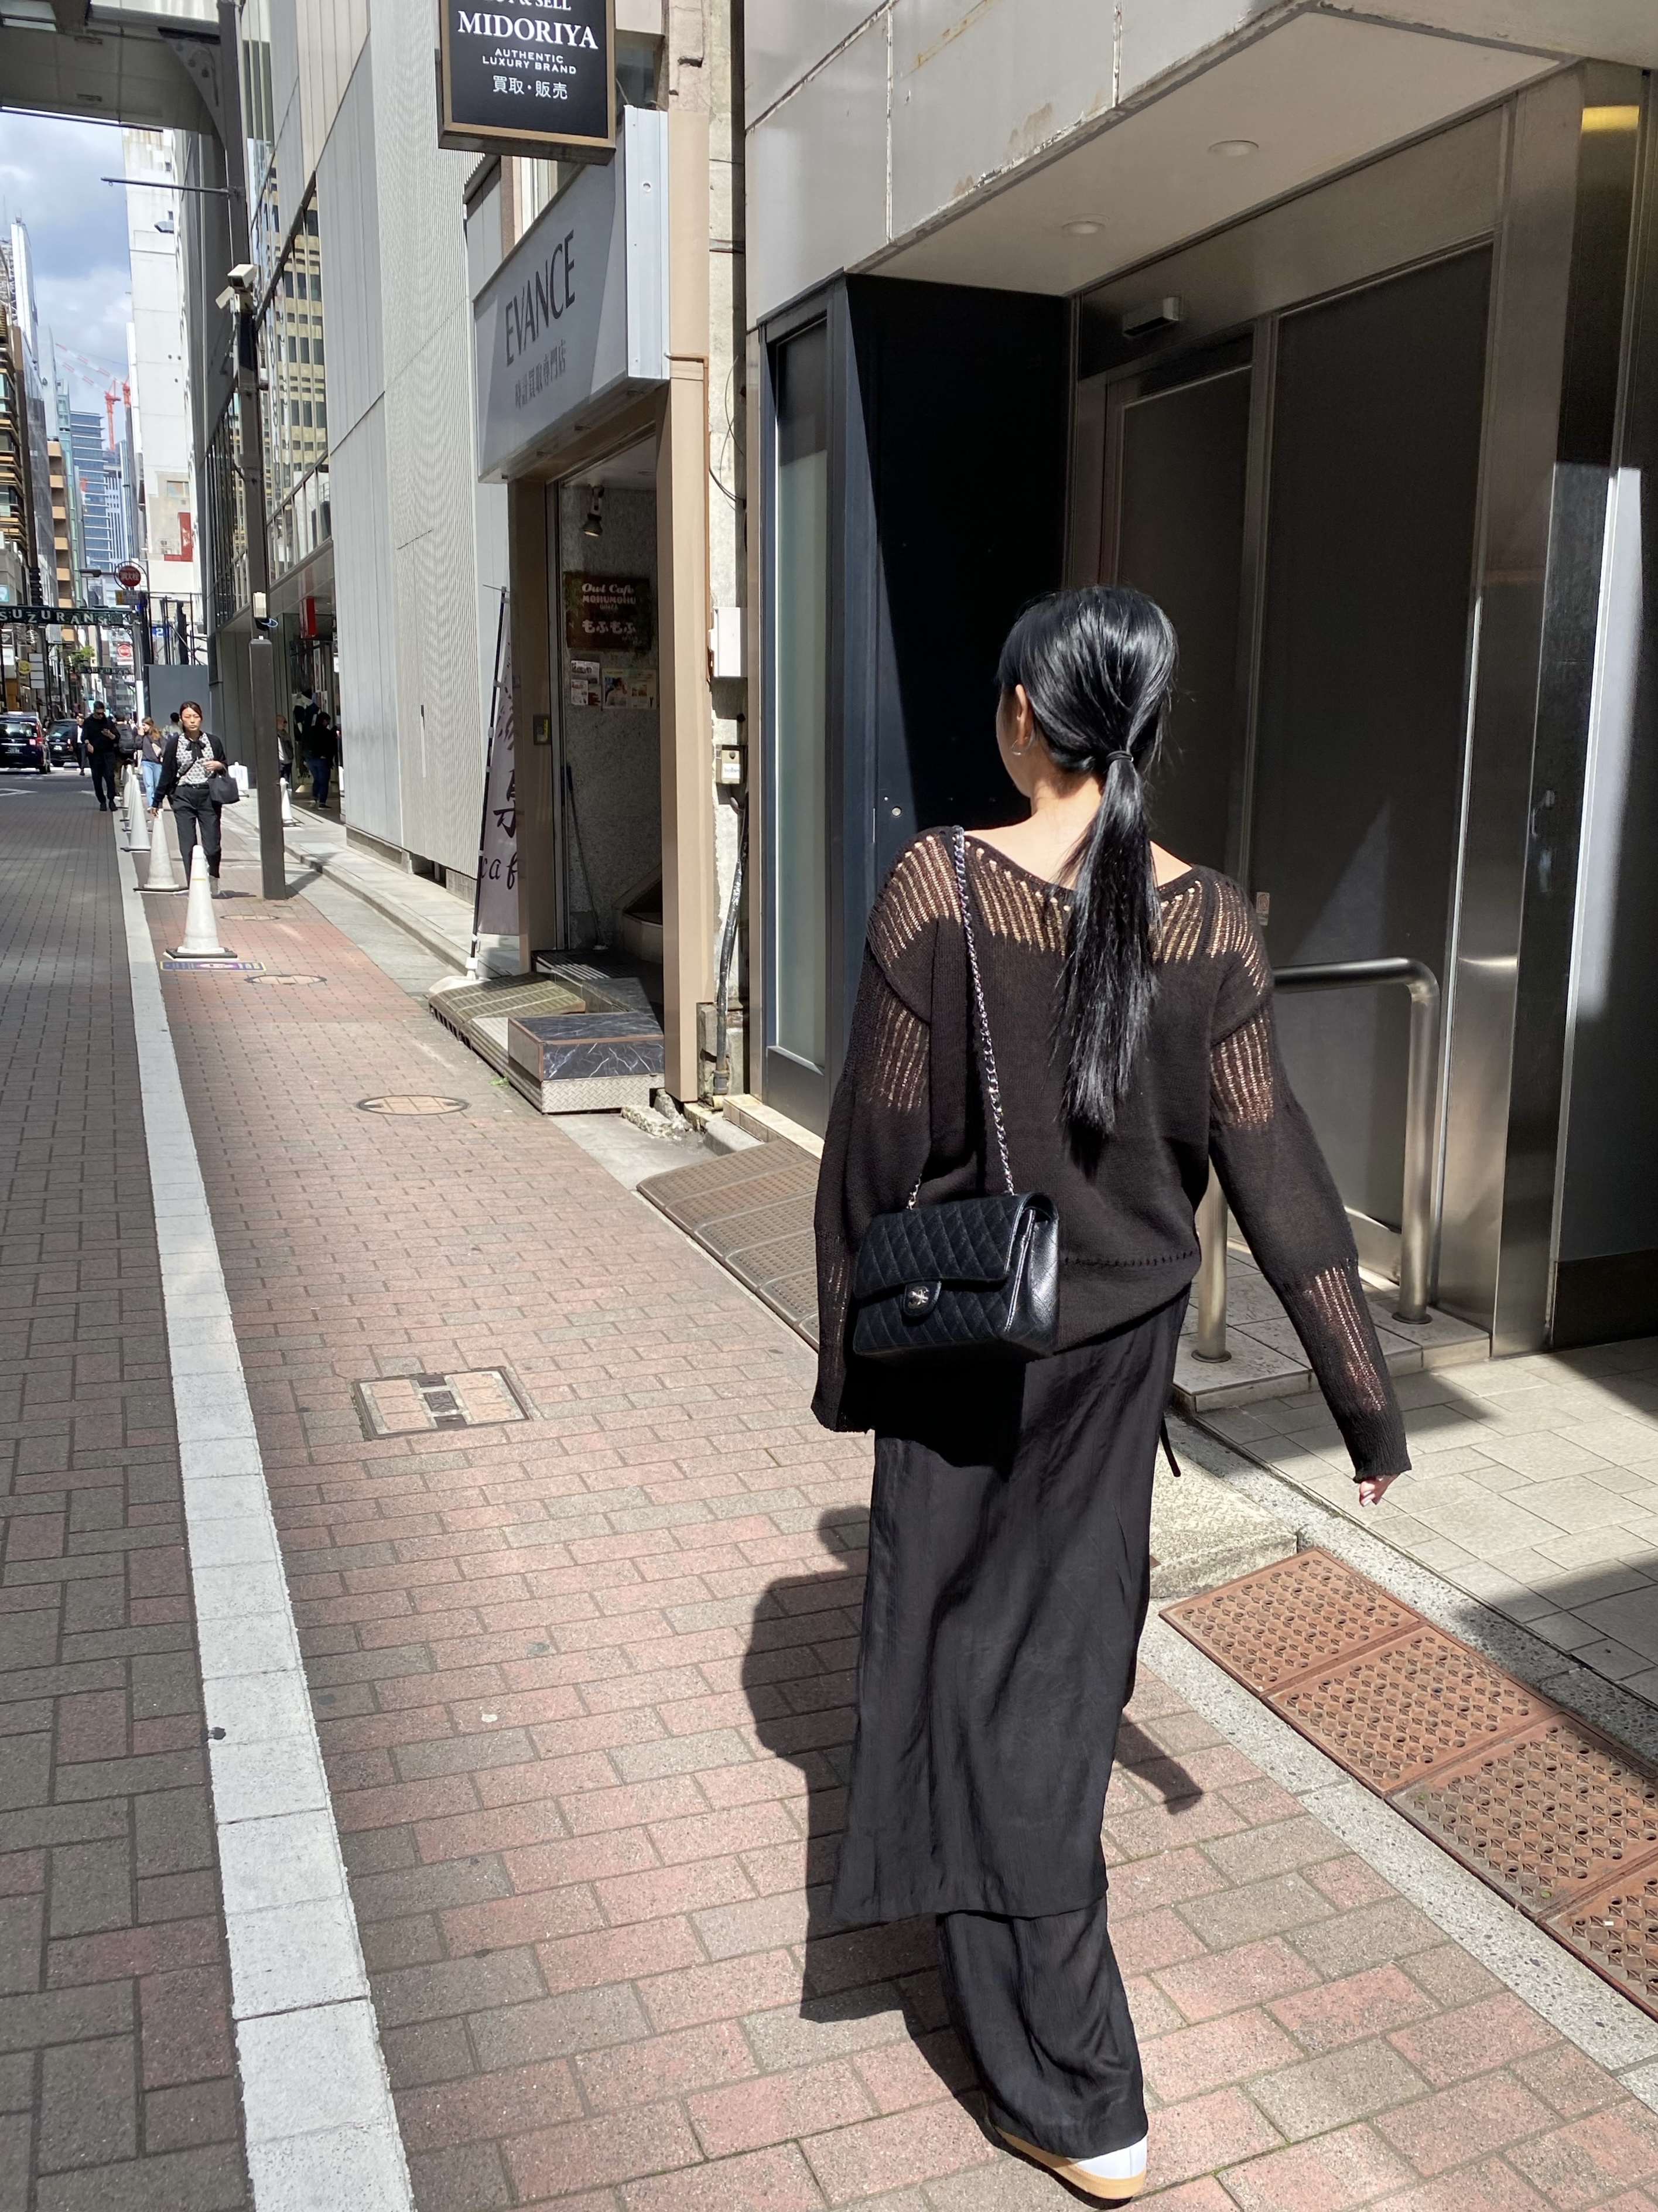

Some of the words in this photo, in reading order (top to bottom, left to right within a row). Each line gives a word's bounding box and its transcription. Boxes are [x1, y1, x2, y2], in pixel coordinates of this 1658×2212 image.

[457, 11, 599, 49] MIDORIYA
[495, 48, 563, 64] AUTHENTIC
[482, 56, 529, 69] LUXURY
[535, 62, 577, 74] BRAND
[493, 75, 568, 100] 買取・販売
[505, 229, 575, 367] EVANCE
[582, 583, 606, 593] Owl
[582, 595, 637, 605] MOHUMOHU
[0, 609, 94, 624] SUZURAN
[582, 619, 637, 633] もふもふ
[480, 851, 518, 890] caf
